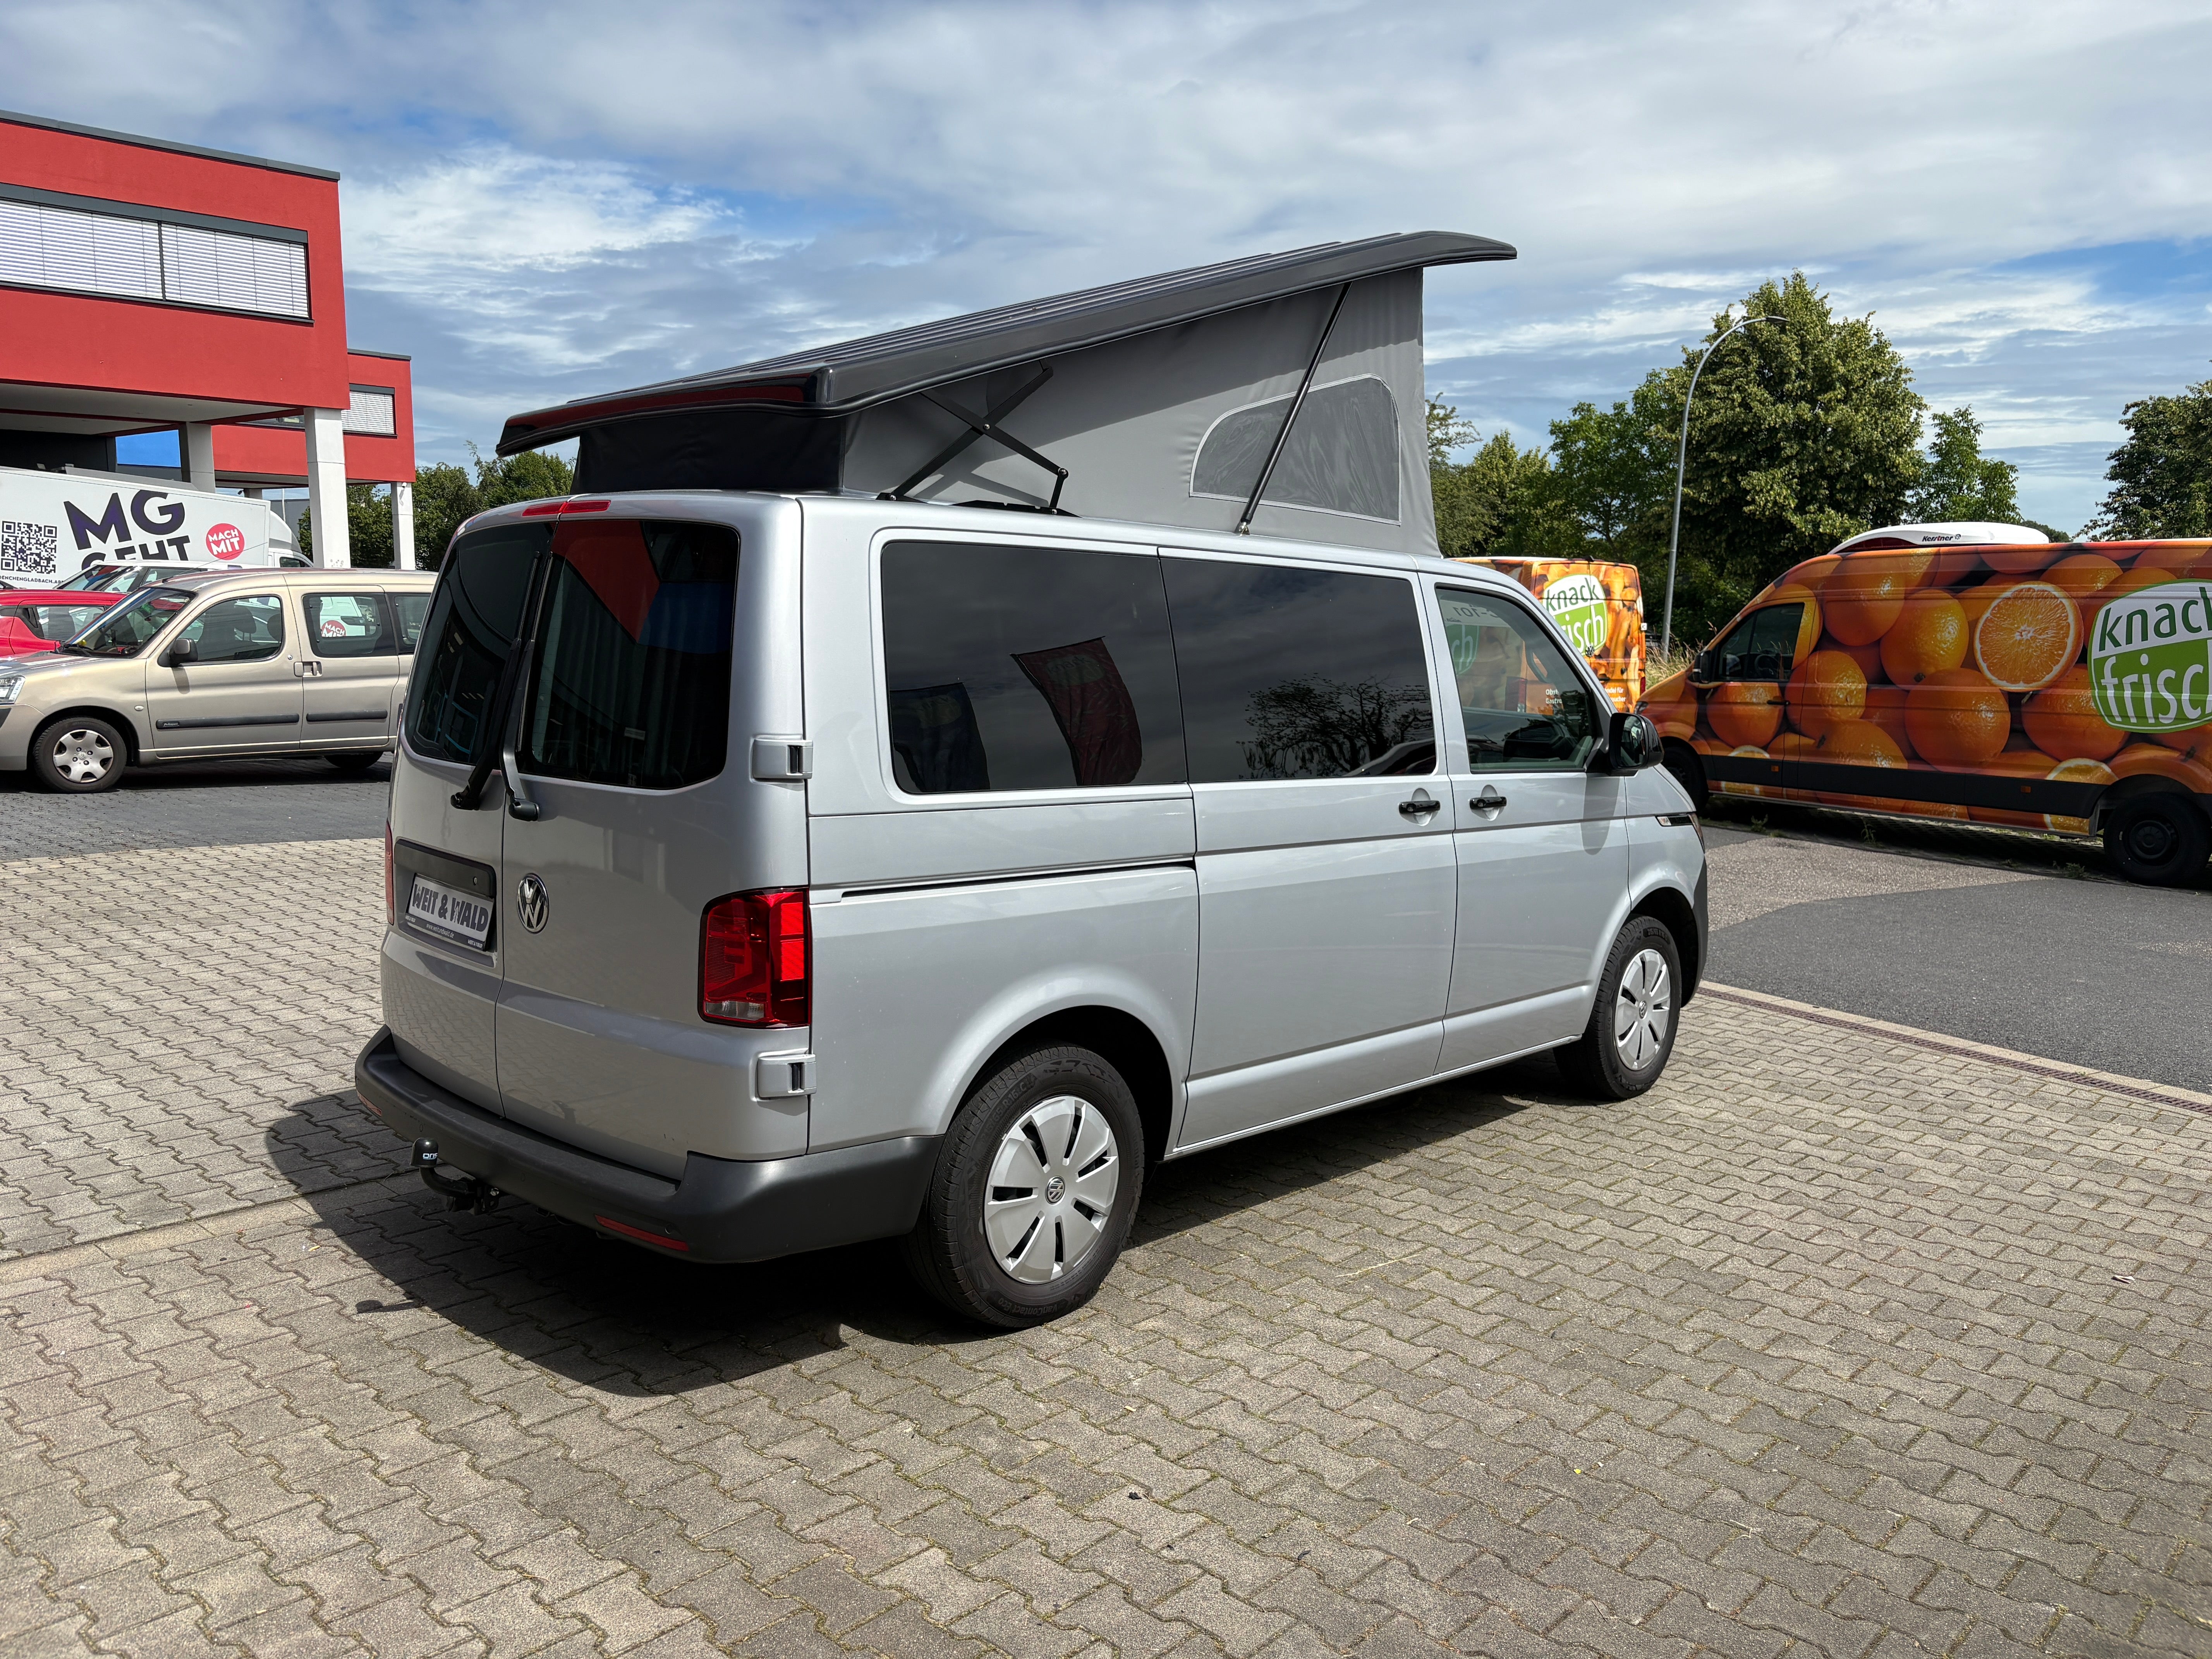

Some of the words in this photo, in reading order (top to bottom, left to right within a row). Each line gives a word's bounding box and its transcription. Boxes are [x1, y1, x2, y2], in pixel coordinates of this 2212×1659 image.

[64, 489, 185, 550] MG
[208, 529, 239, 543] MACH
[210, 538, 240, 555] MIT
[1546, 577, 1600, 611] knack
[325, 622, 345, 635] MACH
[412, 884, 439, 915] WEIT
[438, 894, 448, 920] &
[450, 897, 489, 932] WALD
